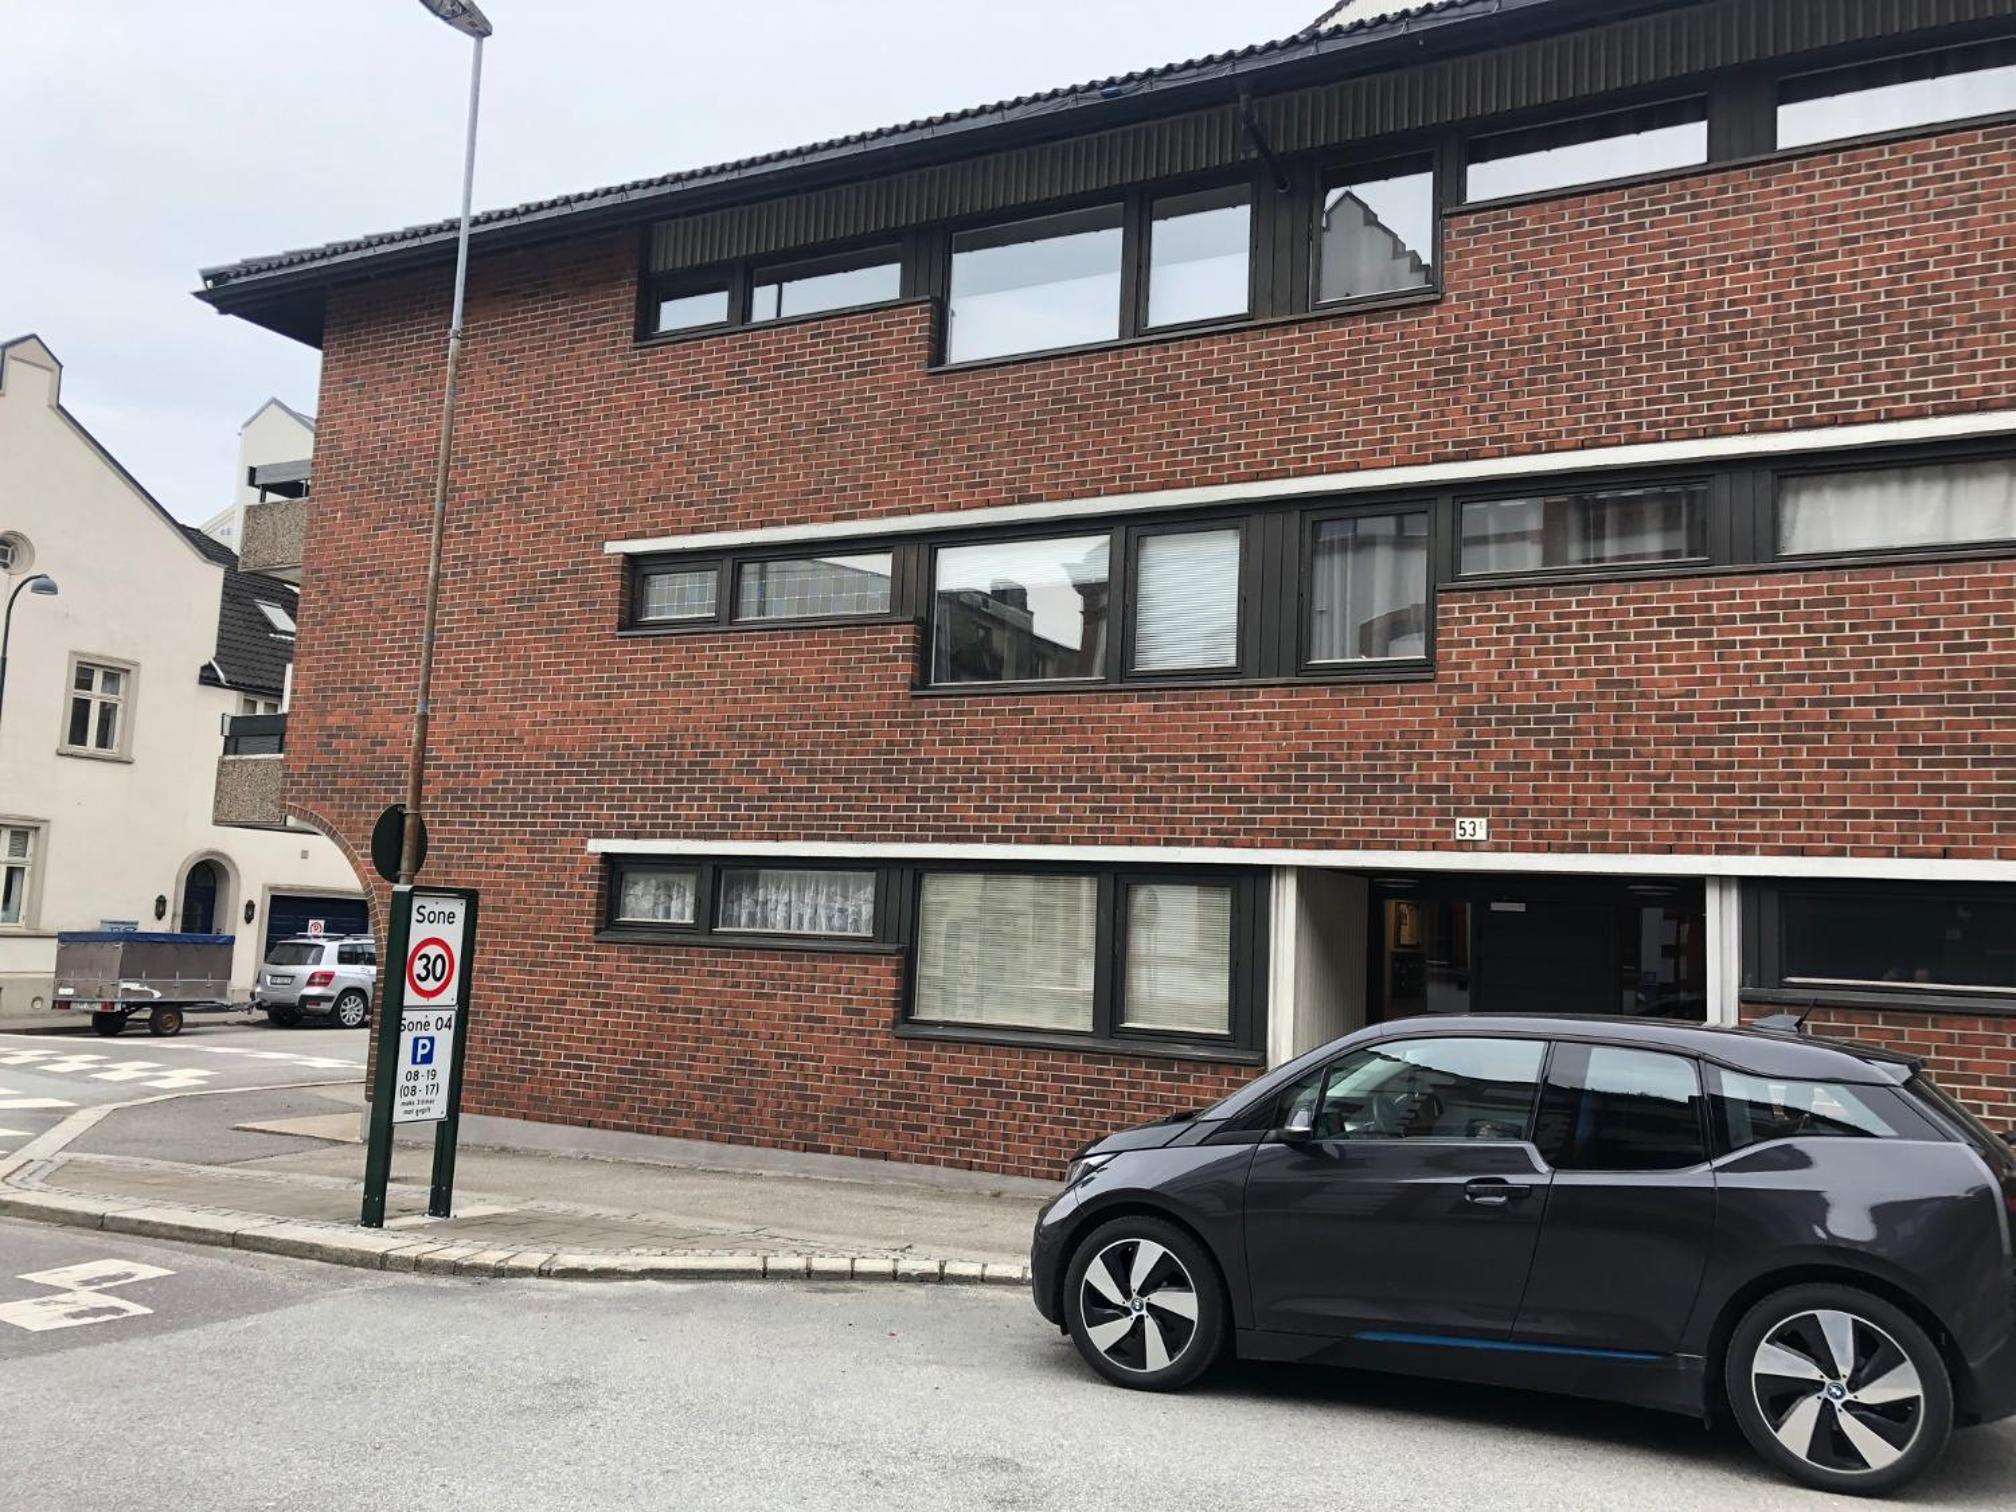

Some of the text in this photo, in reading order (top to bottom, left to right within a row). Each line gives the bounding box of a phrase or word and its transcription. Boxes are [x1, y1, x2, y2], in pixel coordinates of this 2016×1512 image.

[416, 905, 456, 925] Sone
[416, 953, 447, 982] 30
[435, 1015, 453, 1031] 04
